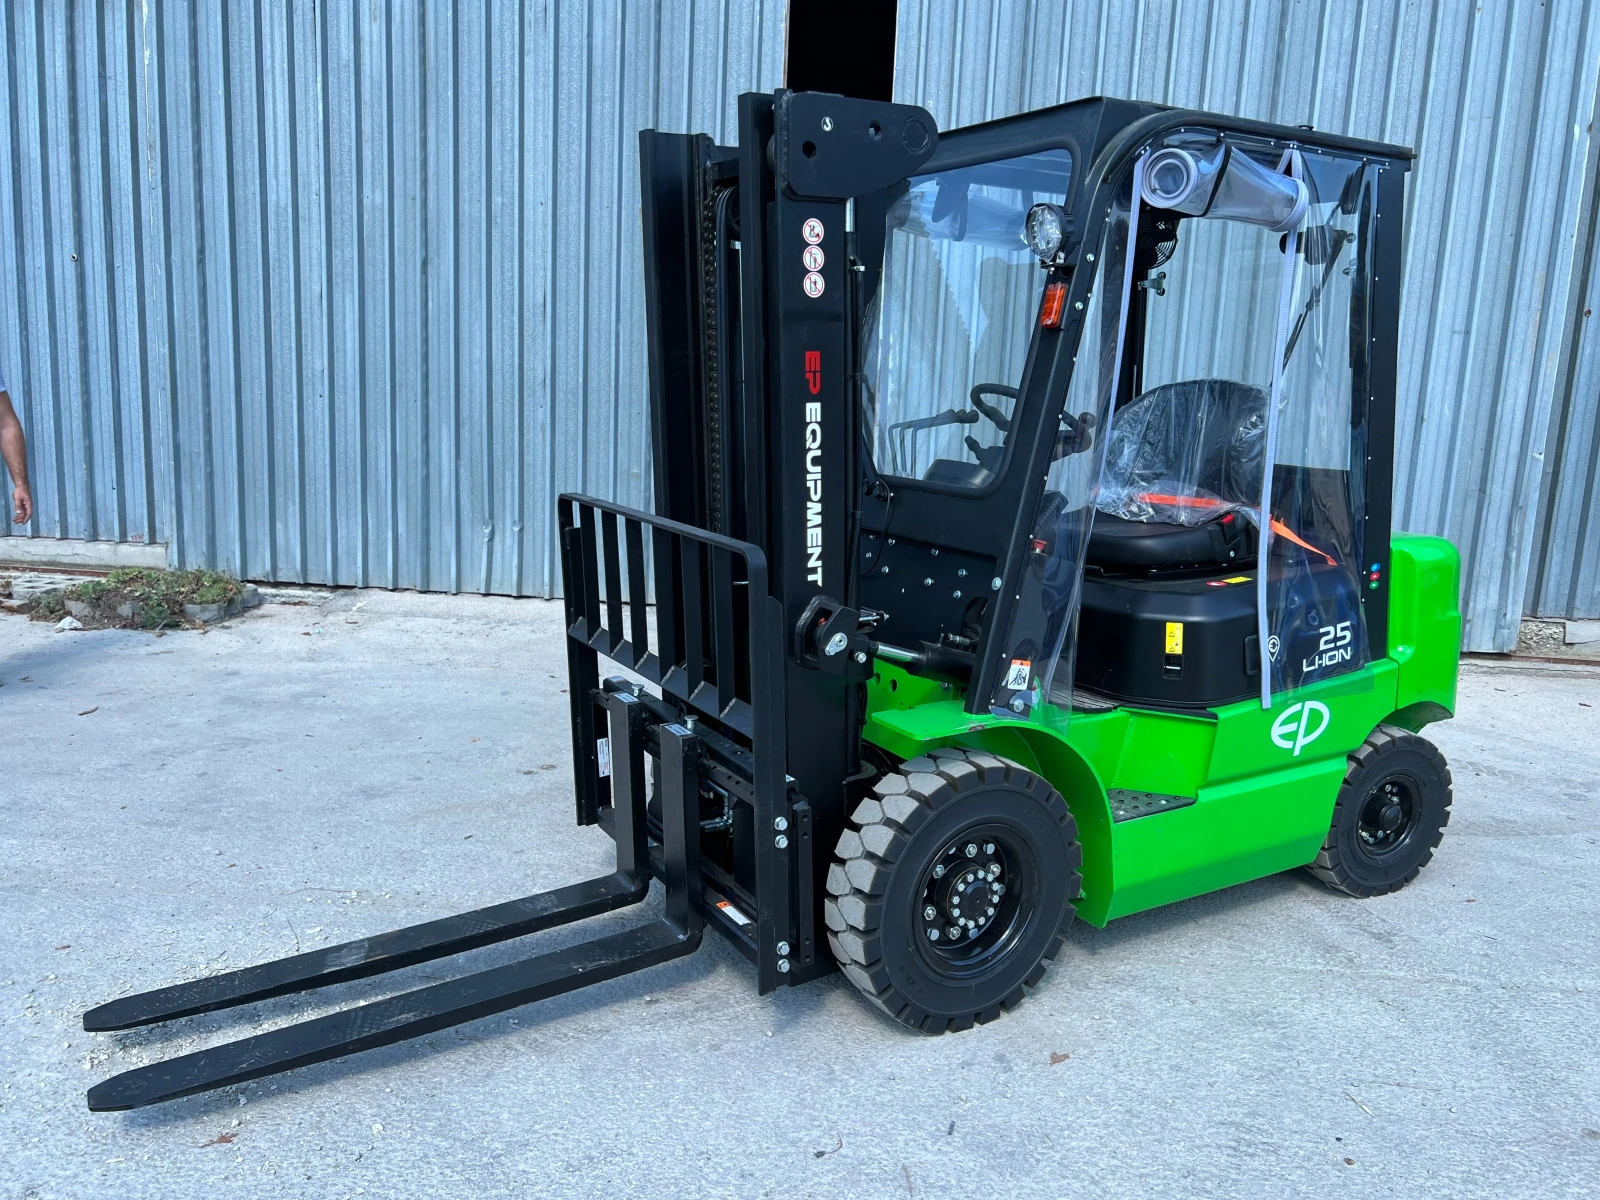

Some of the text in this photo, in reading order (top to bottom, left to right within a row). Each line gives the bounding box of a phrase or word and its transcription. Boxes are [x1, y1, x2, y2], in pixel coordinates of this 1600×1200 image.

[805, 351, 823, 587] EP EQUIPMENT
[1319, 621, 1352, 650] 25
[1270, 700, 1330, 757] EP
